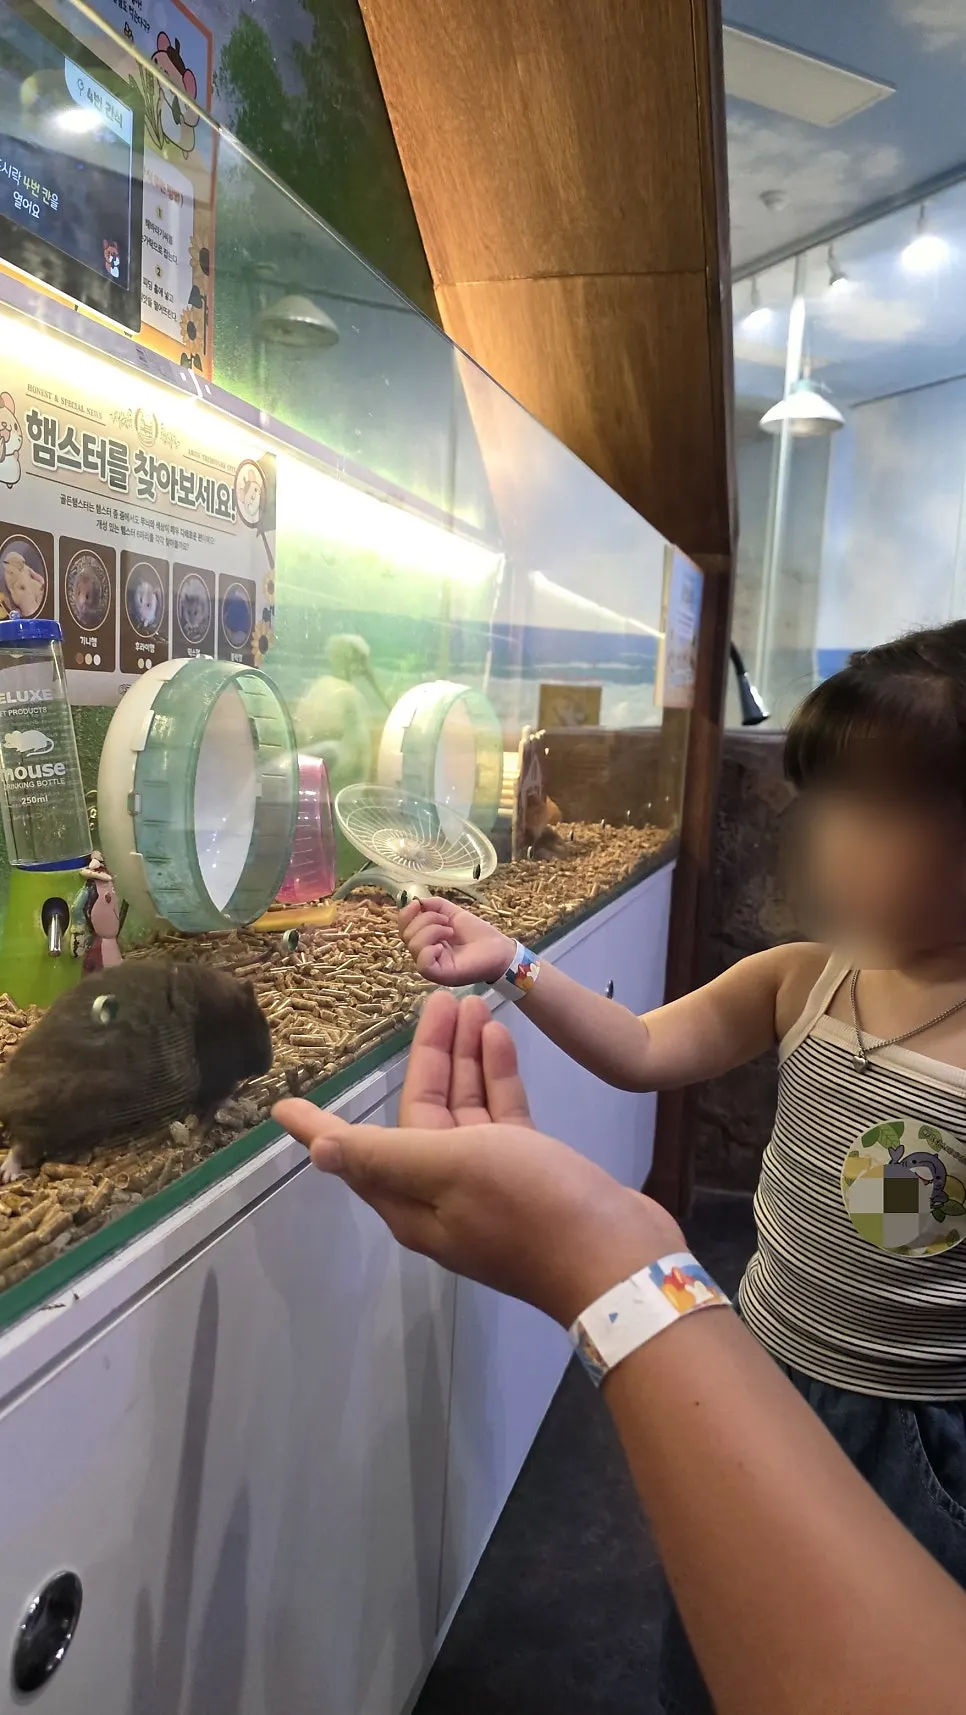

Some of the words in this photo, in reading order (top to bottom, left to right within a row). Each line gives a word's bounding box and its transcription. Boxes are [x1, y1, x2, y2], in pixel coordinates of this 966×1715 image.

[86, 87, 103, 109] 4번
[105, 100, 123, 129] 간식
[23, 175, 40, 199] 4번
[41, 186, 59, 211] 칸을
[13, 190, 40, 219] 열어요
[27, 383, 52, 400] HONEST
[53, 394, 60, 404] &
[60, 397, 85, 414] SPECIAL
[86, 407, 103, 420] NEWS
[25, 408, 130, 492] 햄스터를
[133, 448, 238, 522] 찾아보세요!
[60, 493, 95, 513] 골든햄스터는
[95, 503, 112, 518] 햄스터
[96, 519, 108, 532] 개성
[108, 522, 120, 535] 있는
[120, 525, 136, 538] 햄스터
[79, 636, 98, 648] 기니햄
[135, 641, 156, 654] 후라이햄
[8, 706, 48, 716] PRODUCTS
[1, 762, 66, 781] mouse
[4, 781, 35, 790] DRINKING
[36, 778, 66, 787] BOTTLE
[21, 795, 49, 805] 250ml
